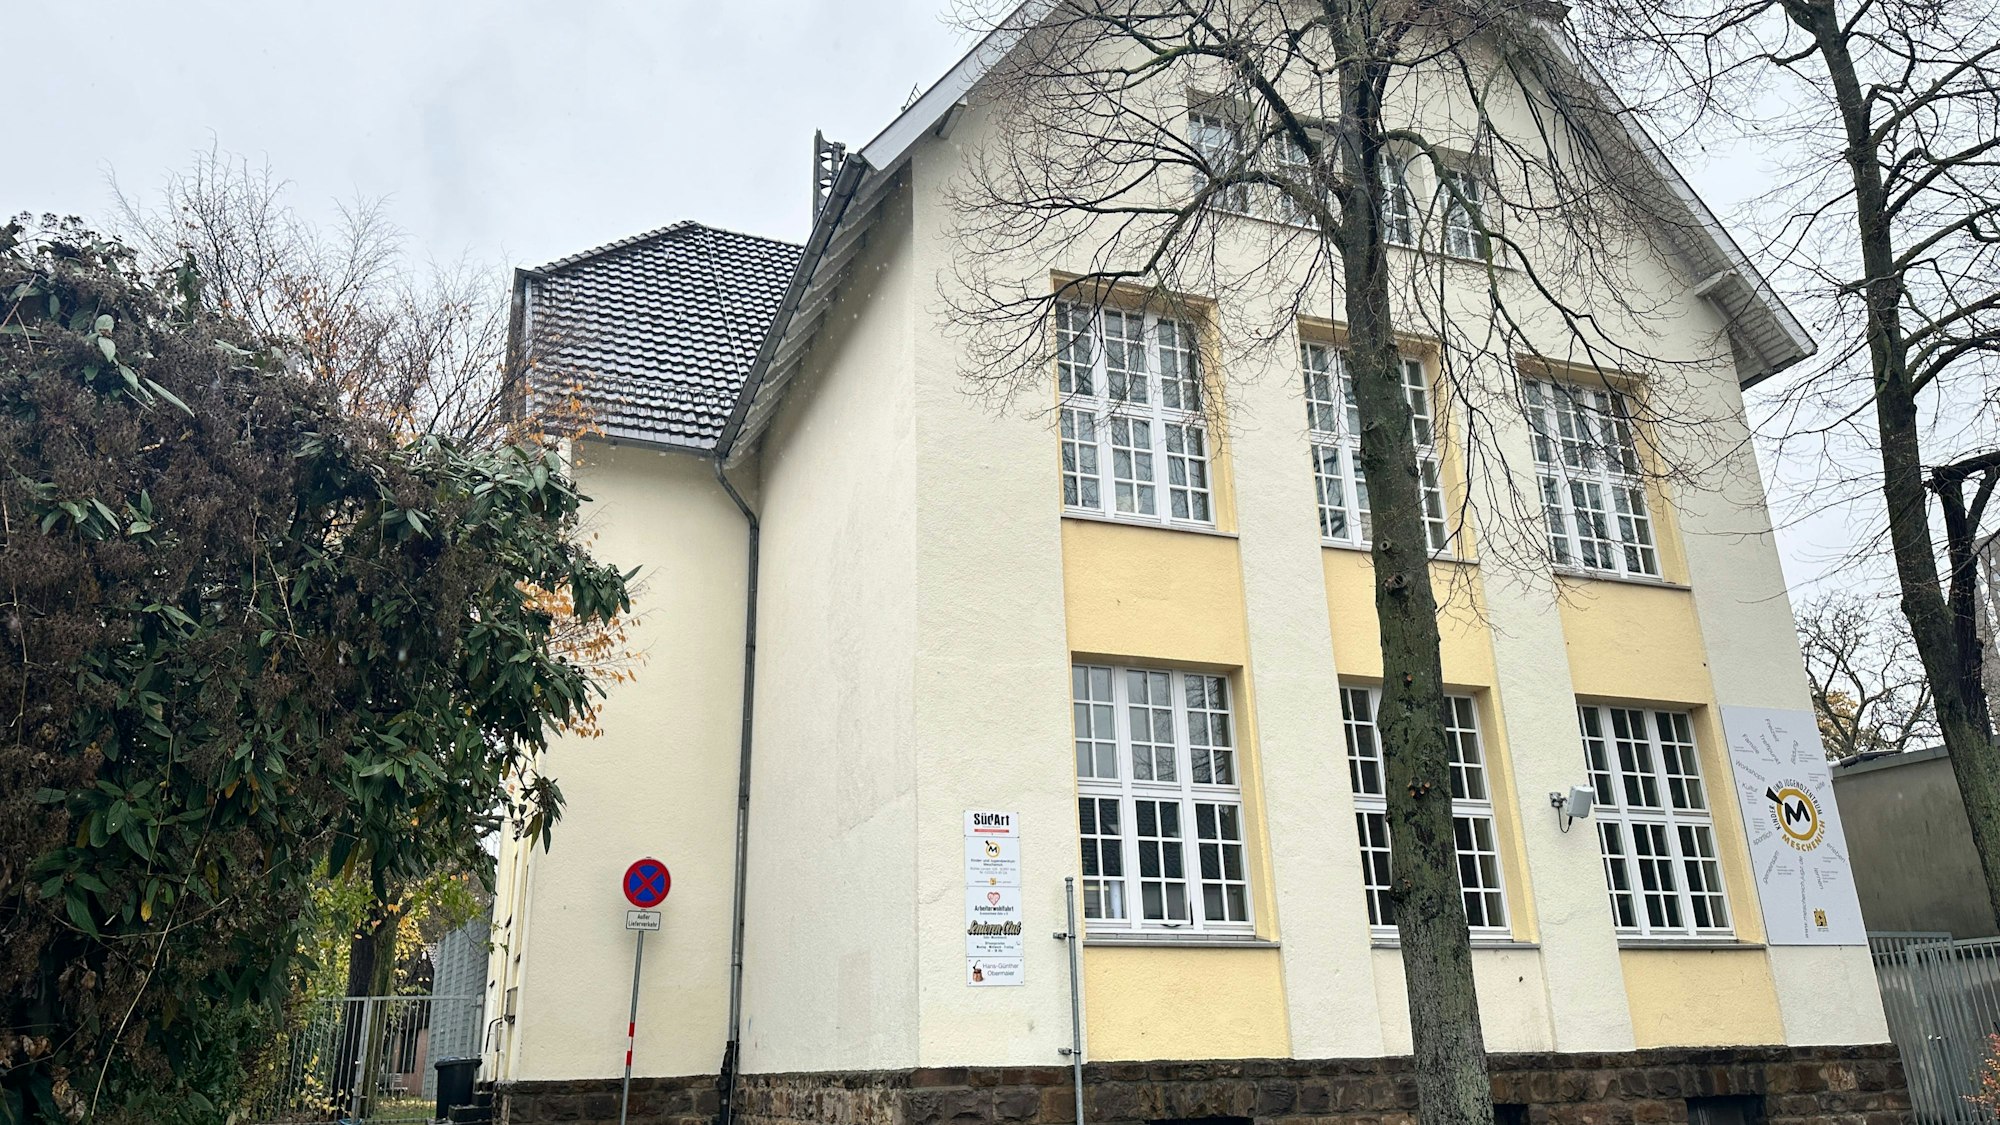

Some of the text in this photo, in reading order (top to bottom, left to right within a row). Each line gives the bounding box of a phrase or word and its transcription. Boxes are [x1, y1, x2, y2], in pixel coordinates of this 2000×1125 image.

[1765, 718, 1779, 742] Freizeit
[1742, 733, 1760, 755] Familie
[1760, 734, 1781, 765] Treffpunkt
[1790, 740, 1799, 766] Bildung
[1735, 760, 1766, 782] Workshops
[1742, 783, 1758, 793] Kultur
[1772, 780, 1784, 792] UND
[1783, 778, 1823, 816] JUGENDZENTRUM
[974, 812, 1010, 826] SüdArt
[1784, 799, 1811, 826] M
[1781, 820, 1826, 852] MESCHENICH
[1826, 842, 1846, 863] erleben
[1762, 850, 1780, 886] gemeinsam
[1814, 867, 1824, 890] lernen
[967, 920, 1022, 936] Senioren Club
